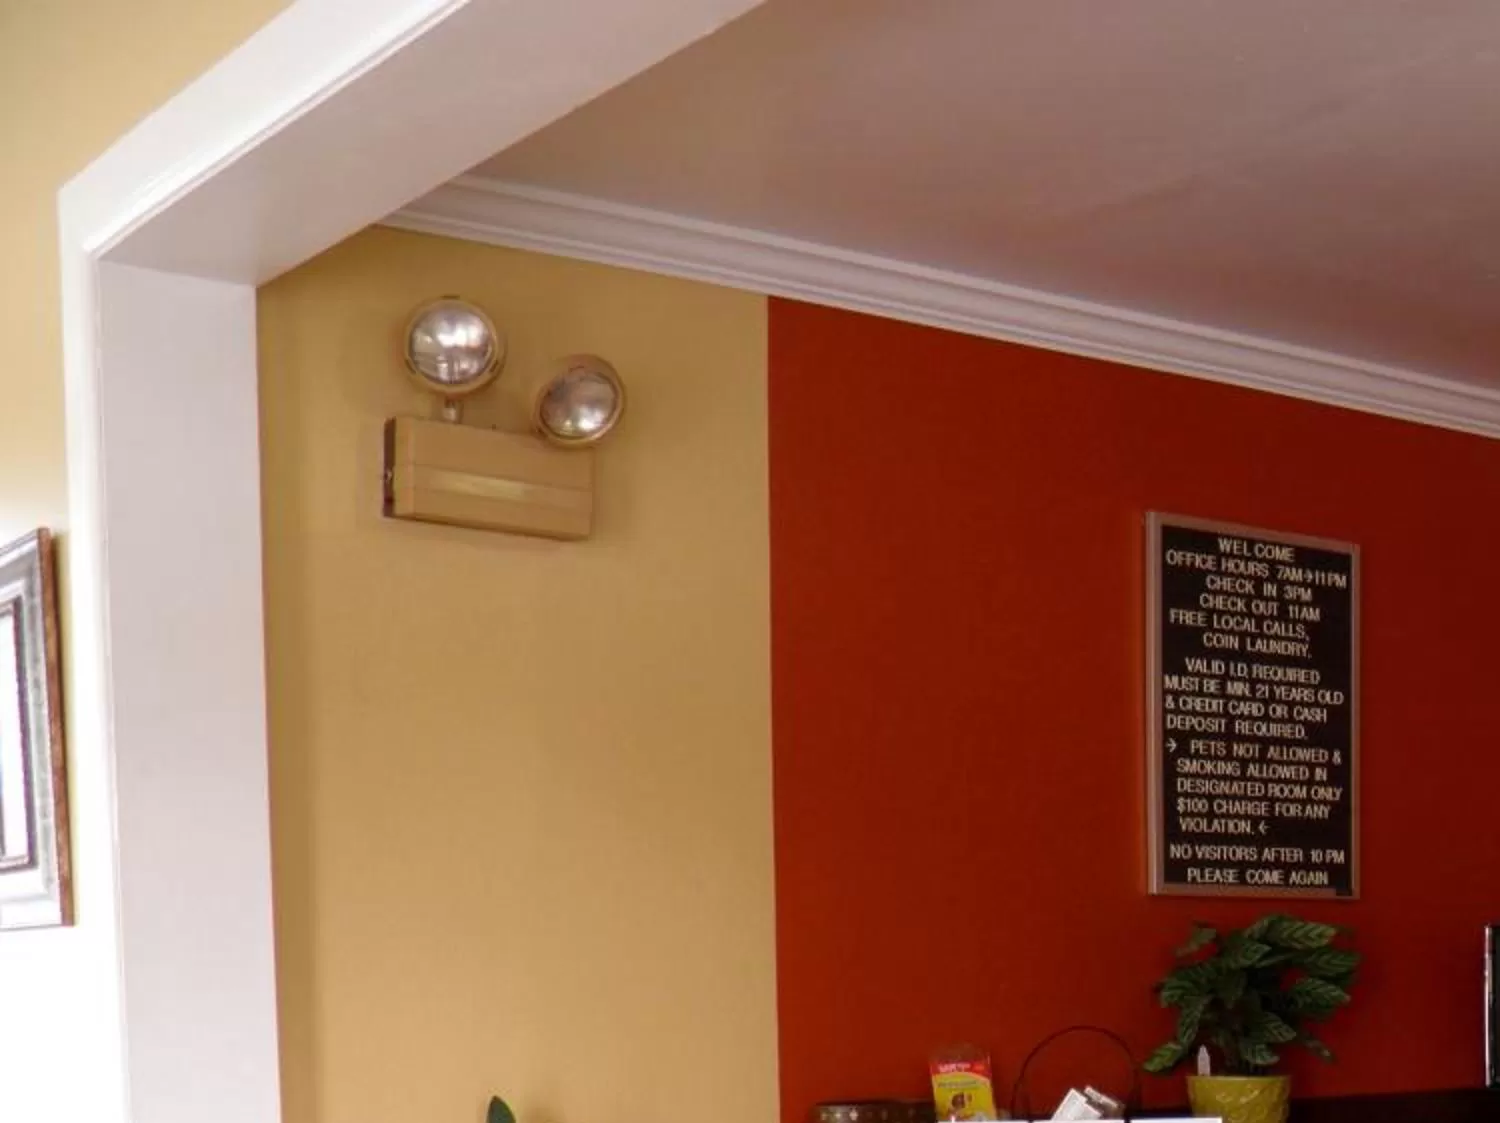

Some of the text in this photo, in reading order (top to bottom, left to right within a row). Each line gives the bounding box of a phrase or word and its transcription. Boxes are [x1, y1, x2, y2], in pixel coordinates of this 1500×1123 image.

[1166, 549, 1217, 571] OFFICE
[1222, 558, 1269, 577] HOURS
[1206, 575, 1313, 602] CHECK IN 3PM
[1199, 593, 1320, 622] CHECK OUT 11AM
[1169, 608, 1208, 626] FREE
[1213, 614, 1260, 633] LOCAL
[1203, 632, 1239, 650] COIN
[1185, 657, 1225, 675] VALID
[1252, 664, 1320, 685] REQUIRED
[1164, 674, 1199, 691] MUST
[1203, 679, 1221, 694] BE
[1255, 684, 1269, 699] 21
[1273, 685, 1315, 703] YEARS
[1317, 690, 1344, 705] OLD
[1165, 695, 1327, 723] & CREDIT CARD OR CASH
[1167, 715, 1226, 733] DEPOSIT
[1191, 740, 1341, 765] PETS NOT ALLOWED &
[1176, 757, 1327, 781] SMOKING ALLOWED IN
[1177, 778, 1343, 801] DESIGNATED ROOM ONLY
[1176, 797, 1331, 820] $100 CHARGE FOR ANY
[1169, 843, 1345, 865] NO VISITORS AFTER 10 PM
[1187, 867, 1328, 886] PLEASE COME AGAIN
